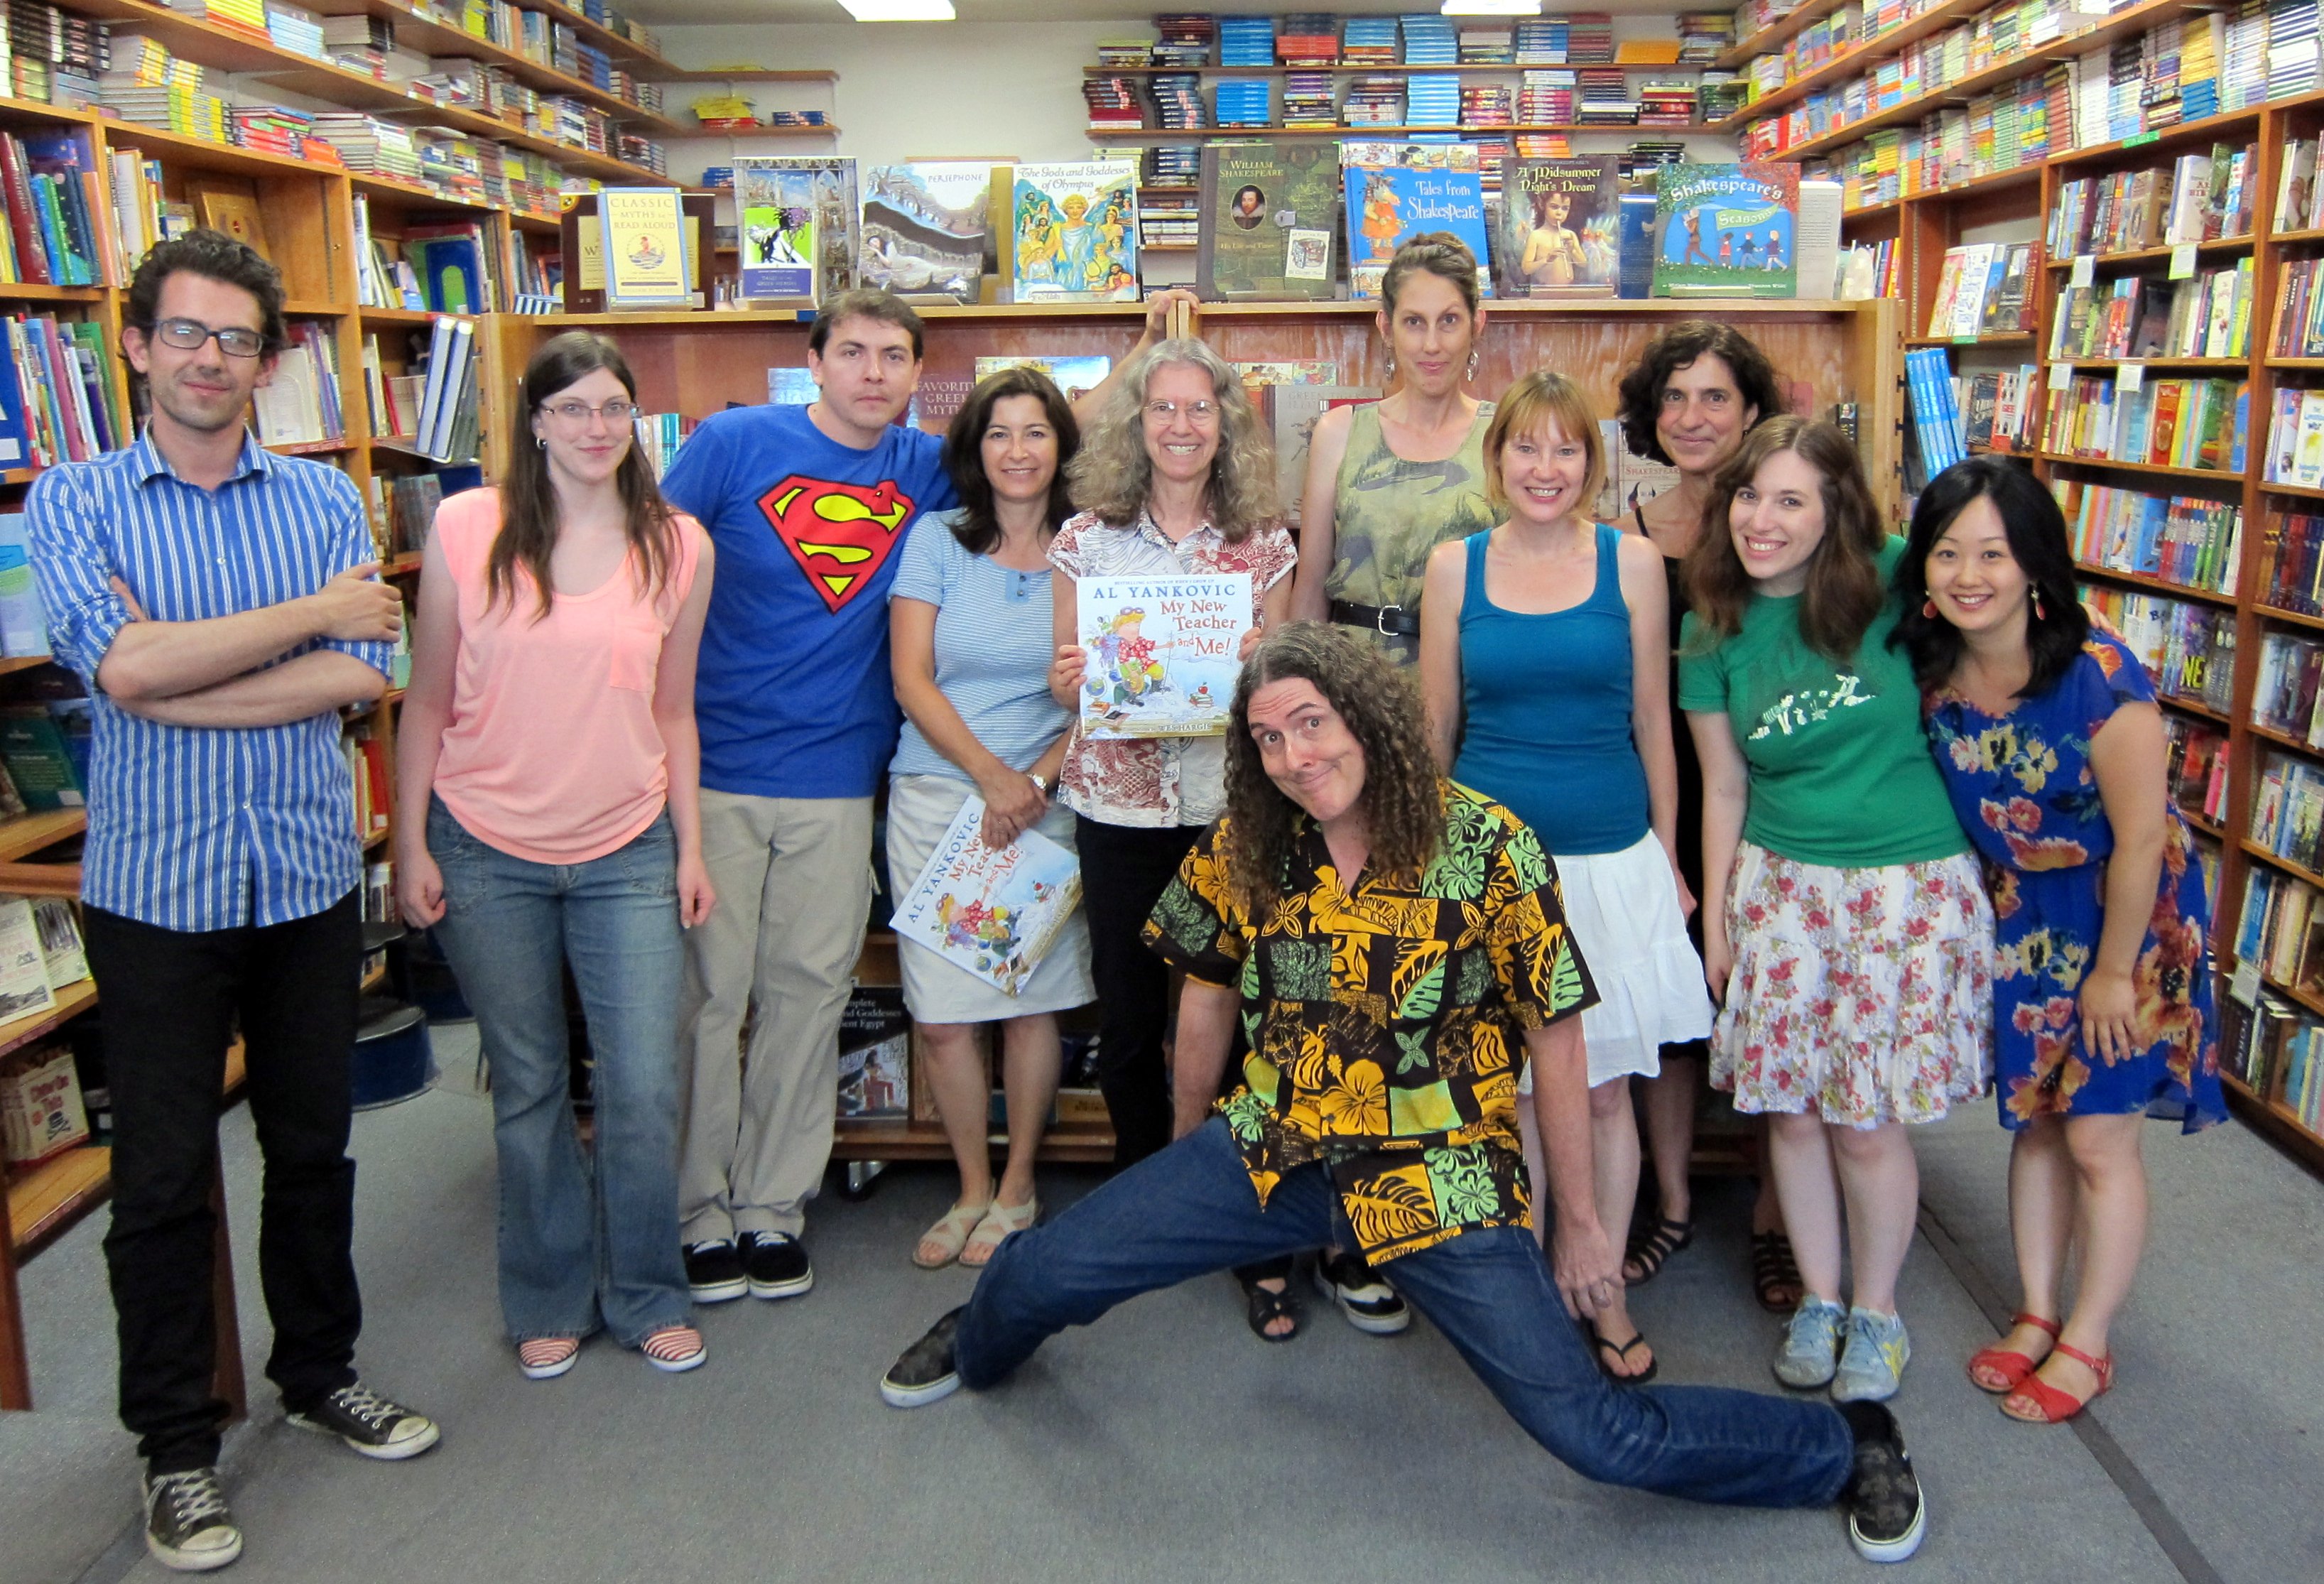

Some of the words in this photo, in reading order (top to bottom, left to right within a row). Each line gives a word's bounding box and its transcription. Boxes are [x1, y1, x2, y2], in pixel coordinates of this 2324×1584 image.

[1018, 167, 1040, 178] The
[1041, 166, 1064, 178] Gods
[1065, 166, 1083, 177] and
[1085, 165, 1130, 176] Goddesses
[1230, 161, 1274, 169] WILLIAM
[928, 173, 983, 183] PERSEPHONE
[1219, 169, 1284, 178] SHAKESPEARE
[1513, 166, 1528, 179] A
[1531, 166, 1602, 185] Midsummer
[1041, 179, 1052, 192] of
[1053, 178, 1095, 192] Olympus
[1415, 180, 1443, 196] Tales
[1445, 179, 1471, 196] from
[1519, 179, 1557, 195] Night's
[1559, 180, 1597, 193] Dream
[1670, 179, 1783, 202] Shakespeare's
[610, 197, 673, 208] CLASSIC
[1407, 196, 1479, 222] Shakespeare
[1719, 210, 1772, 226] Seasons
[1624, 465, 1680, 475] SHAKESPEAR
[1092, 587, 1118, 600] AL
[1129, 584, 1237, 598] YANKOVIC
[1159, 600, 1185, 616] My
[1190, 599, 1227, 614] New
[1172, 614, 1237, 631] Teacher
[1177, 634, 1195, 648] and
[1194, 636, 1232, 656] Me!
[967, 845, 994, 879] Teac
[994, 843, 1024, 877] Me!
[908, 904, 925, 924] AL
[922, 813, 979, 897] YANKOVIC
[948, 859, 970, 883] My
[848, 998, 876, 1009] mplete
[856, 1008, 901, 1017] Goddesses
[859, 1019, 885, 1030] Egypt
